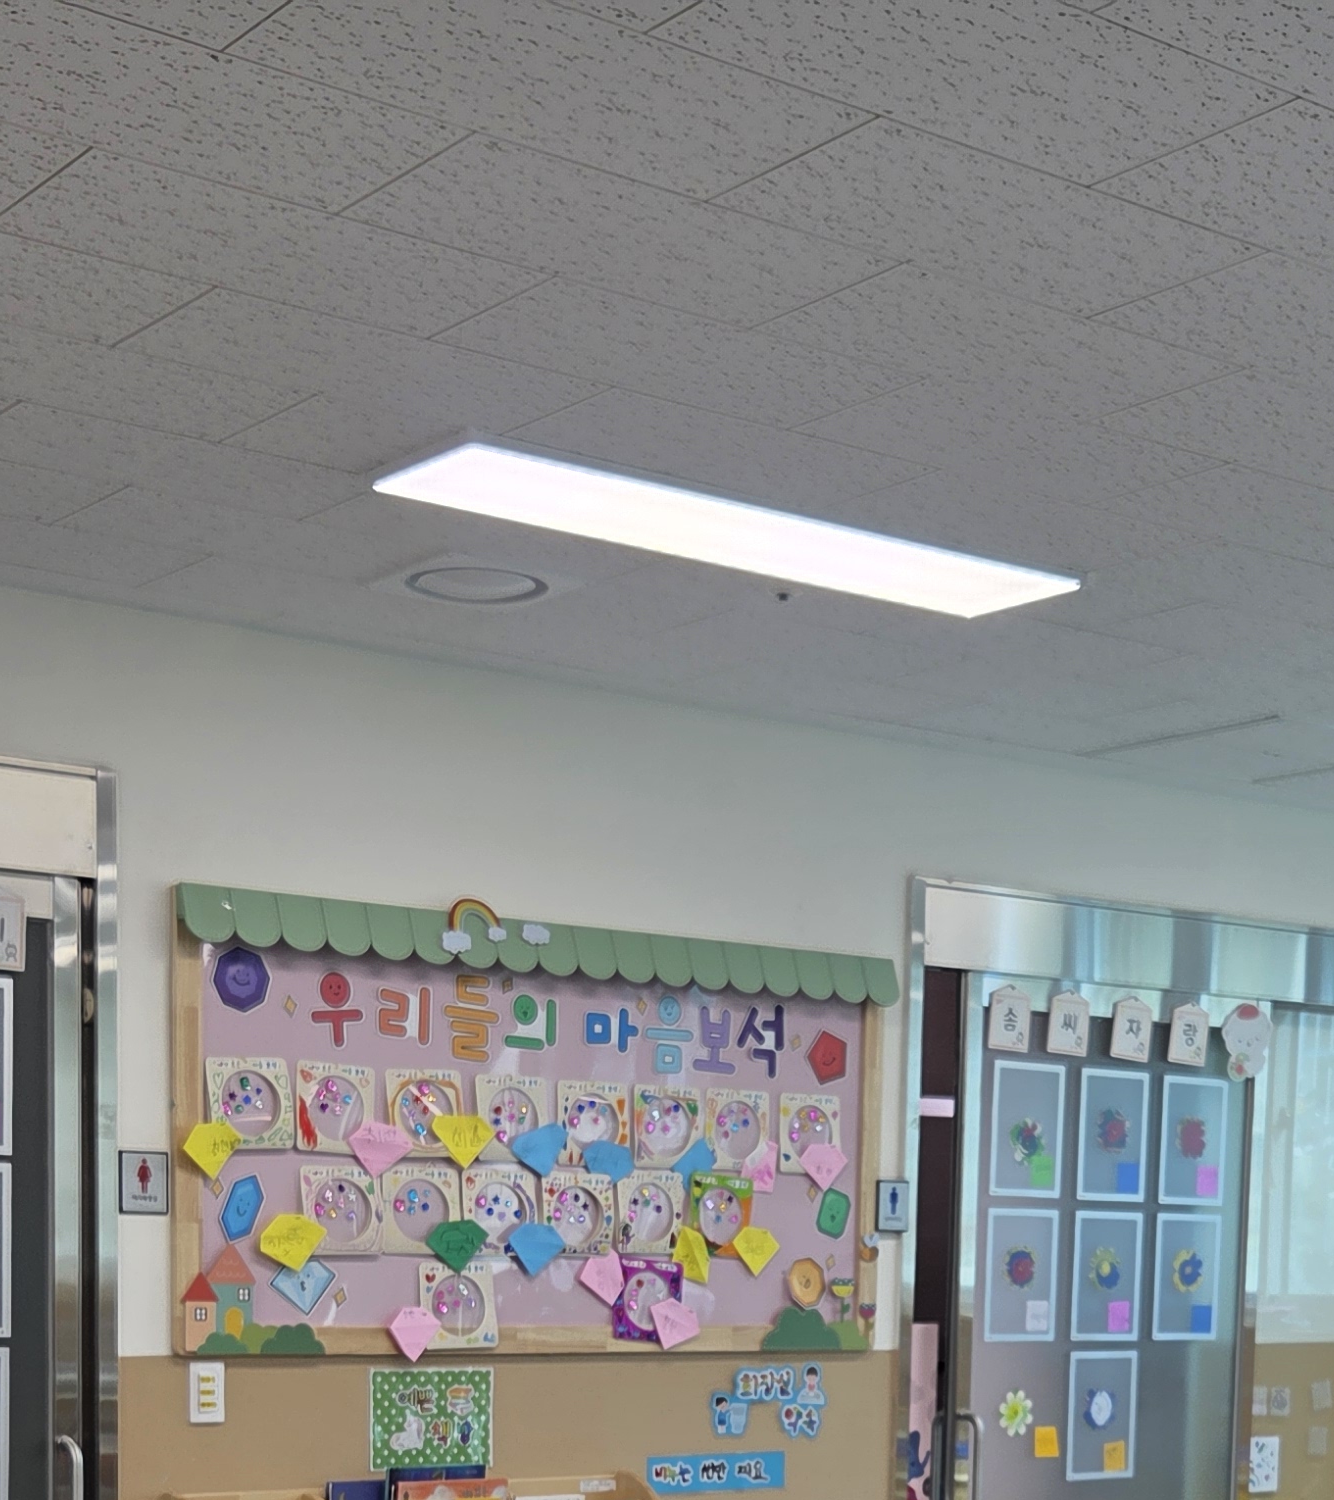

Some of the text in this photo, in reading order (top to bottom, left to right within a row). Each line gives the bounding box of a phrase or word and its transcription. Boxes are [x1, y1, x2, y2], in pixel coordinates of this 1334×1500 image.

[309, 971, 786, 1079] 우리들의 마음보석
[740, 1370, 791, 1397] 화장실
[397, 1386, 435, 1414] 예쁜
[784, 1405, 817, 1434] 약속
[654, 1462, 691, 1483] 비누는
